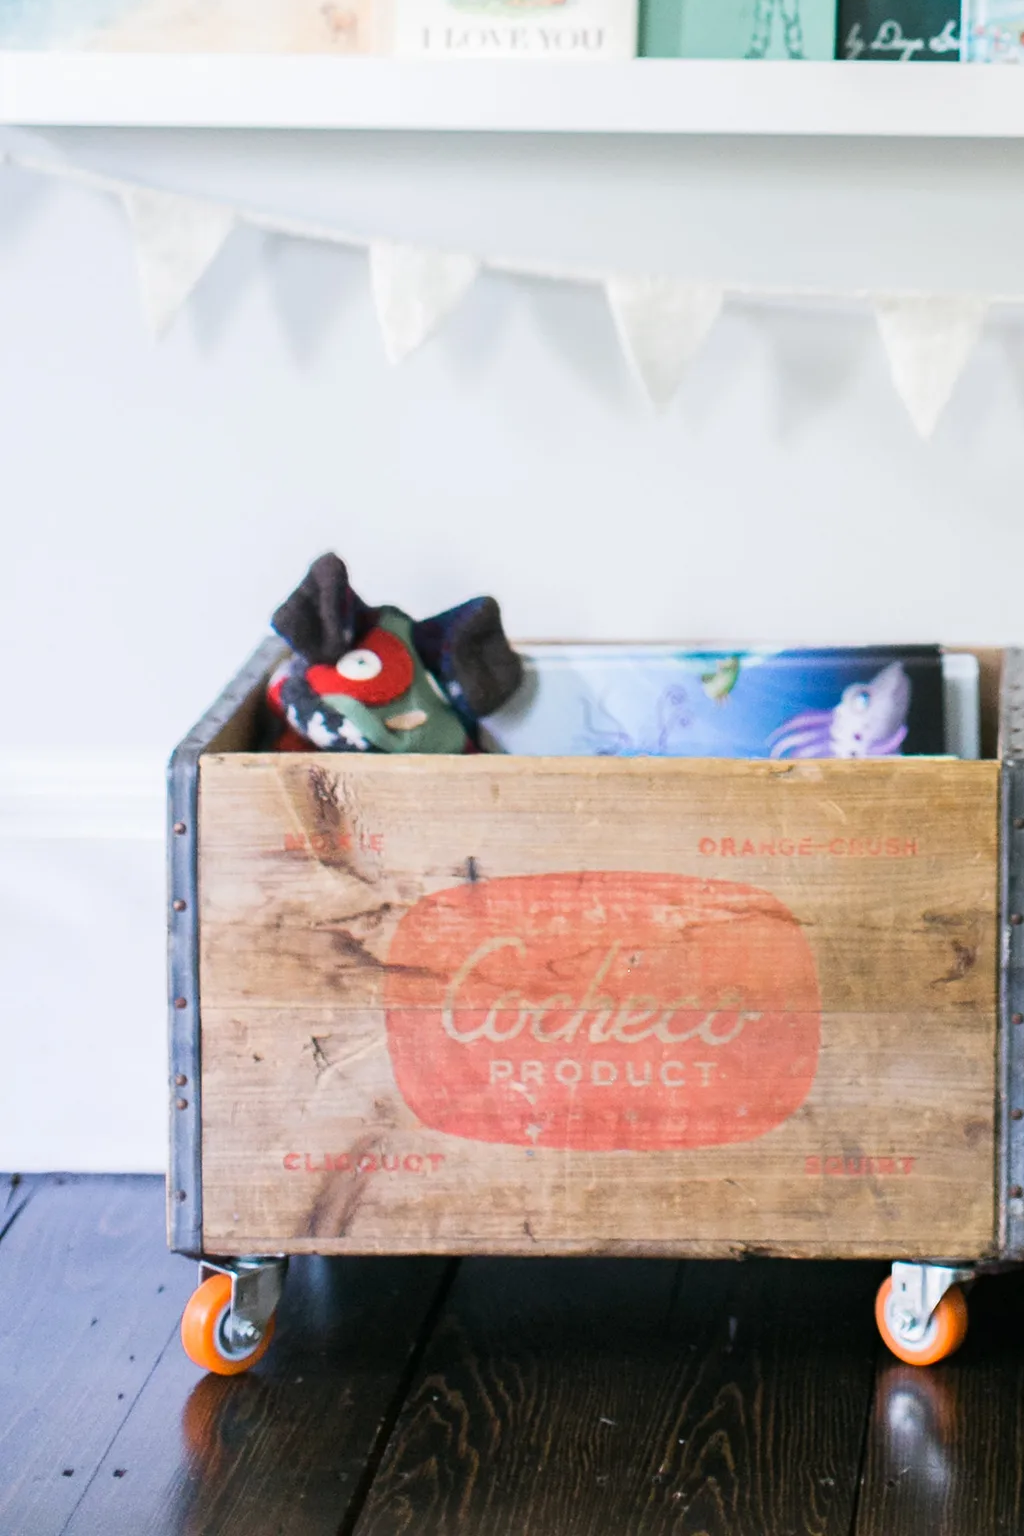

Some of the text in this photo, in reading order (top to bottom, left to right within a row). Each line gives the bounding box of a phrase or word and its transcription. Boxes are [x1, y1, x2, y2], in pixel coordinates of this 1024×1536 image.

[444, 27, 530, 50] LOVE
[537, 27, 606, 51] YOU
[489, 1059, 719, 1088] PRODUCT
